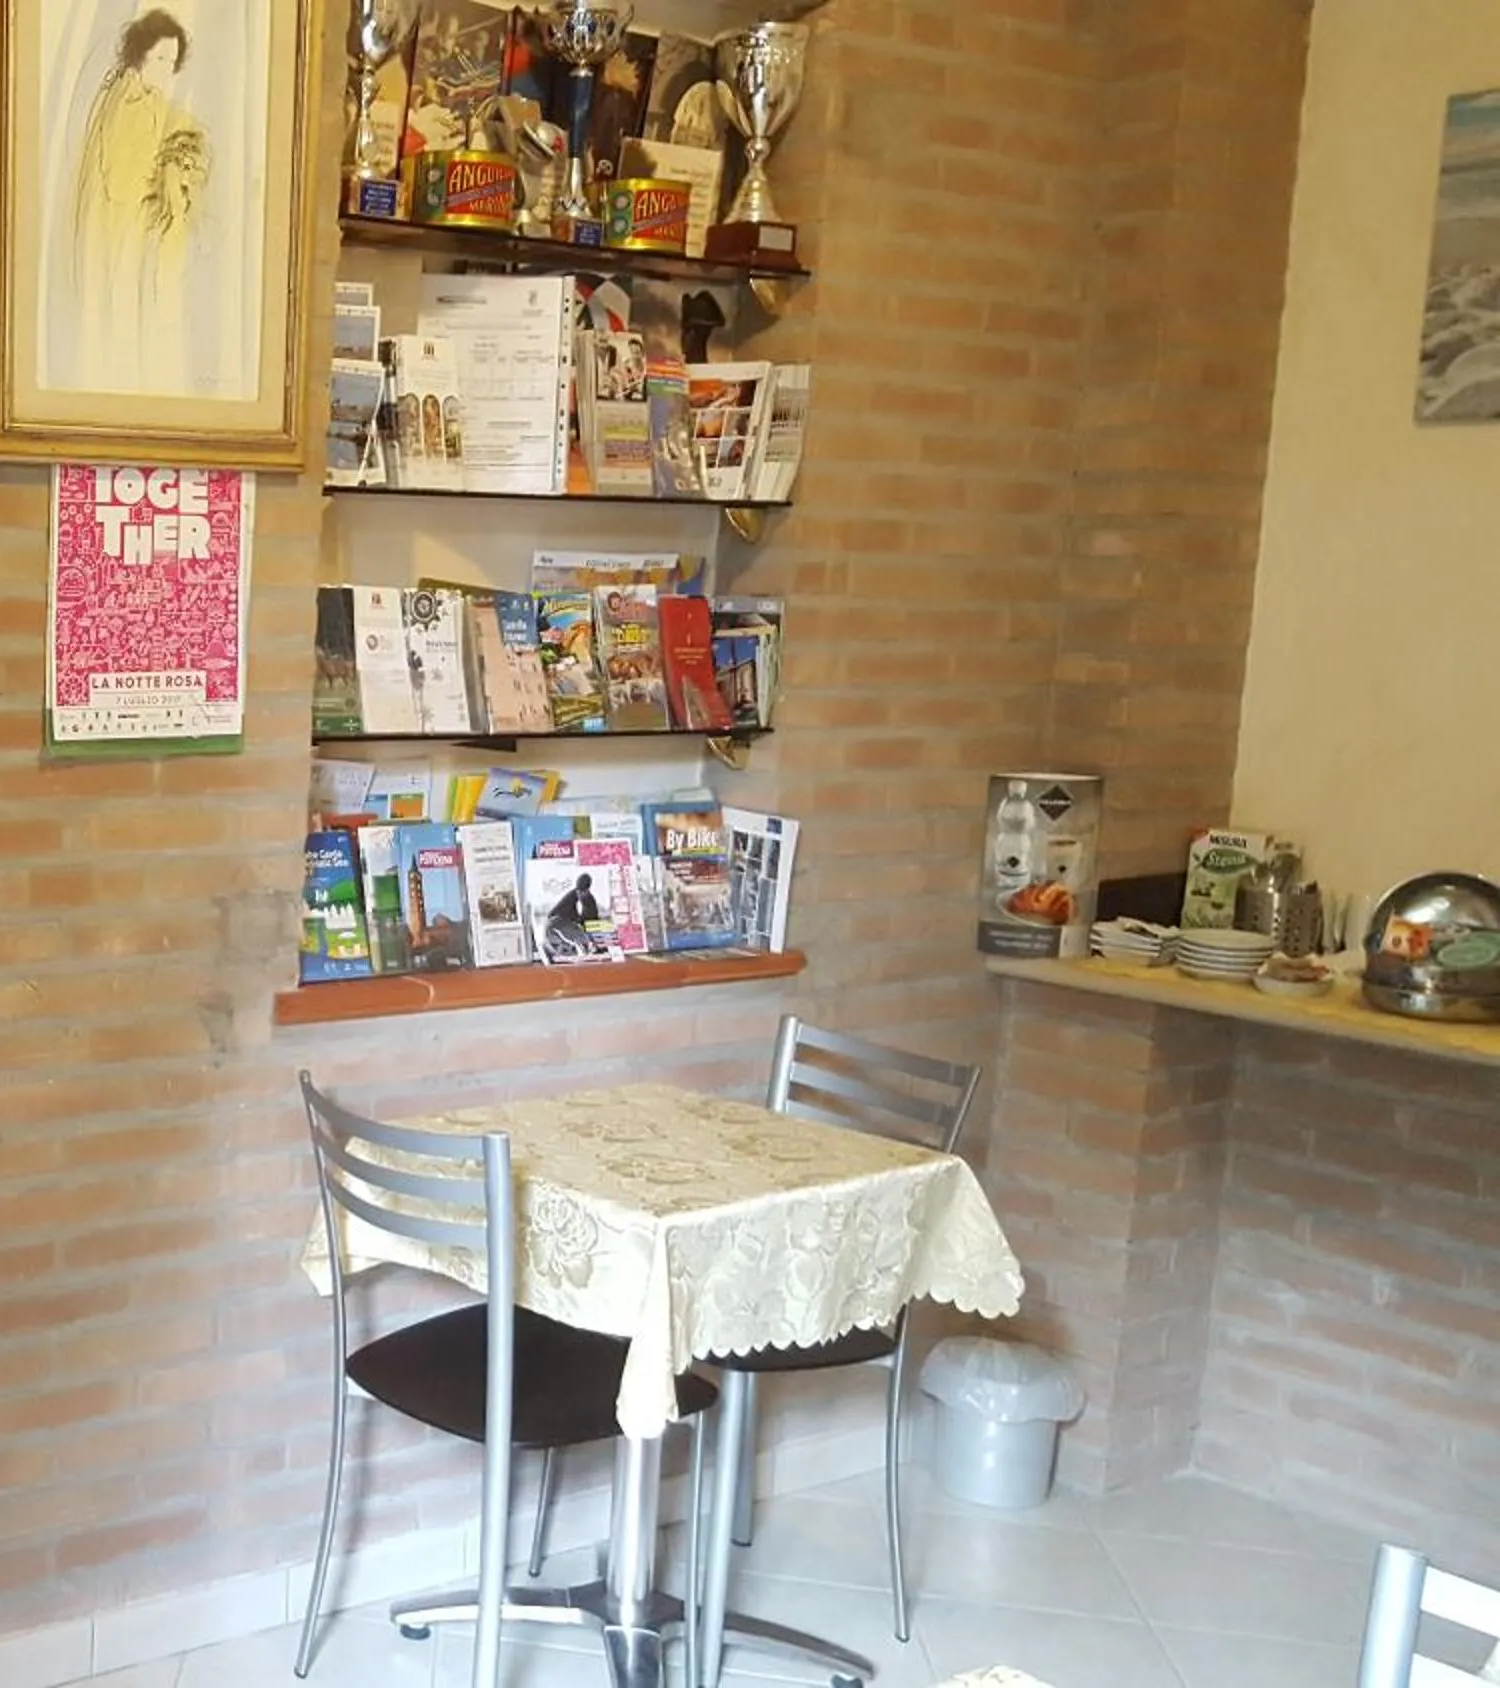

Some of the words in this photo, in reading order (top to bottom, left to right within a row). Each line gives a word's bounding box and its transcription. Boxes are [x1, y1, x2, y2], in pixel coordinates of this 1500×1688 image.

[96, 504, 212, 566] THER
[92, 678, 110, 689] LA
[115, 676, 161, 689] NOTTE
[165, 675, 203, 688] ROSA
[666, 829, 685, 854] By
[687, 826, 717, 847] Bike
